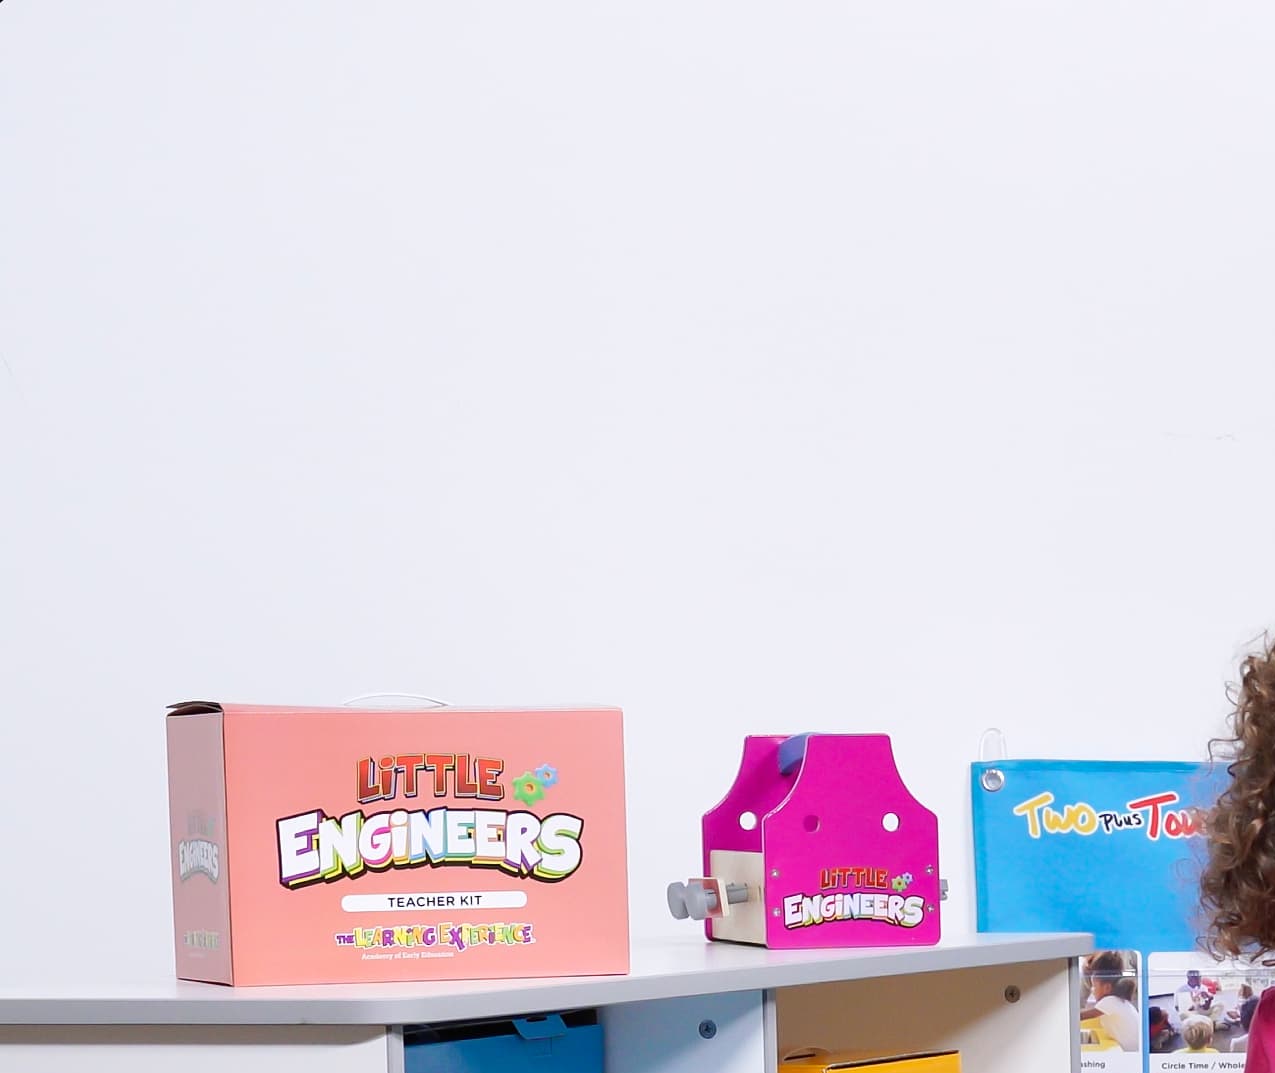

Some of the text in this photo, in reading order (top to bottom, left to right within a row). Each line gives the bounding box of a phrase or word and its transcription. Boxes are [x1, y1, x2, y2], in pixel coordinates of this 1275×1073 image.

[1014, 792, 1098, 838] Two
[387, 895, 483, 908] TEACHER KIT
[1161, 1061, 1186, 1070] Circle
[1188, 1061, 1209, 1070] Time
